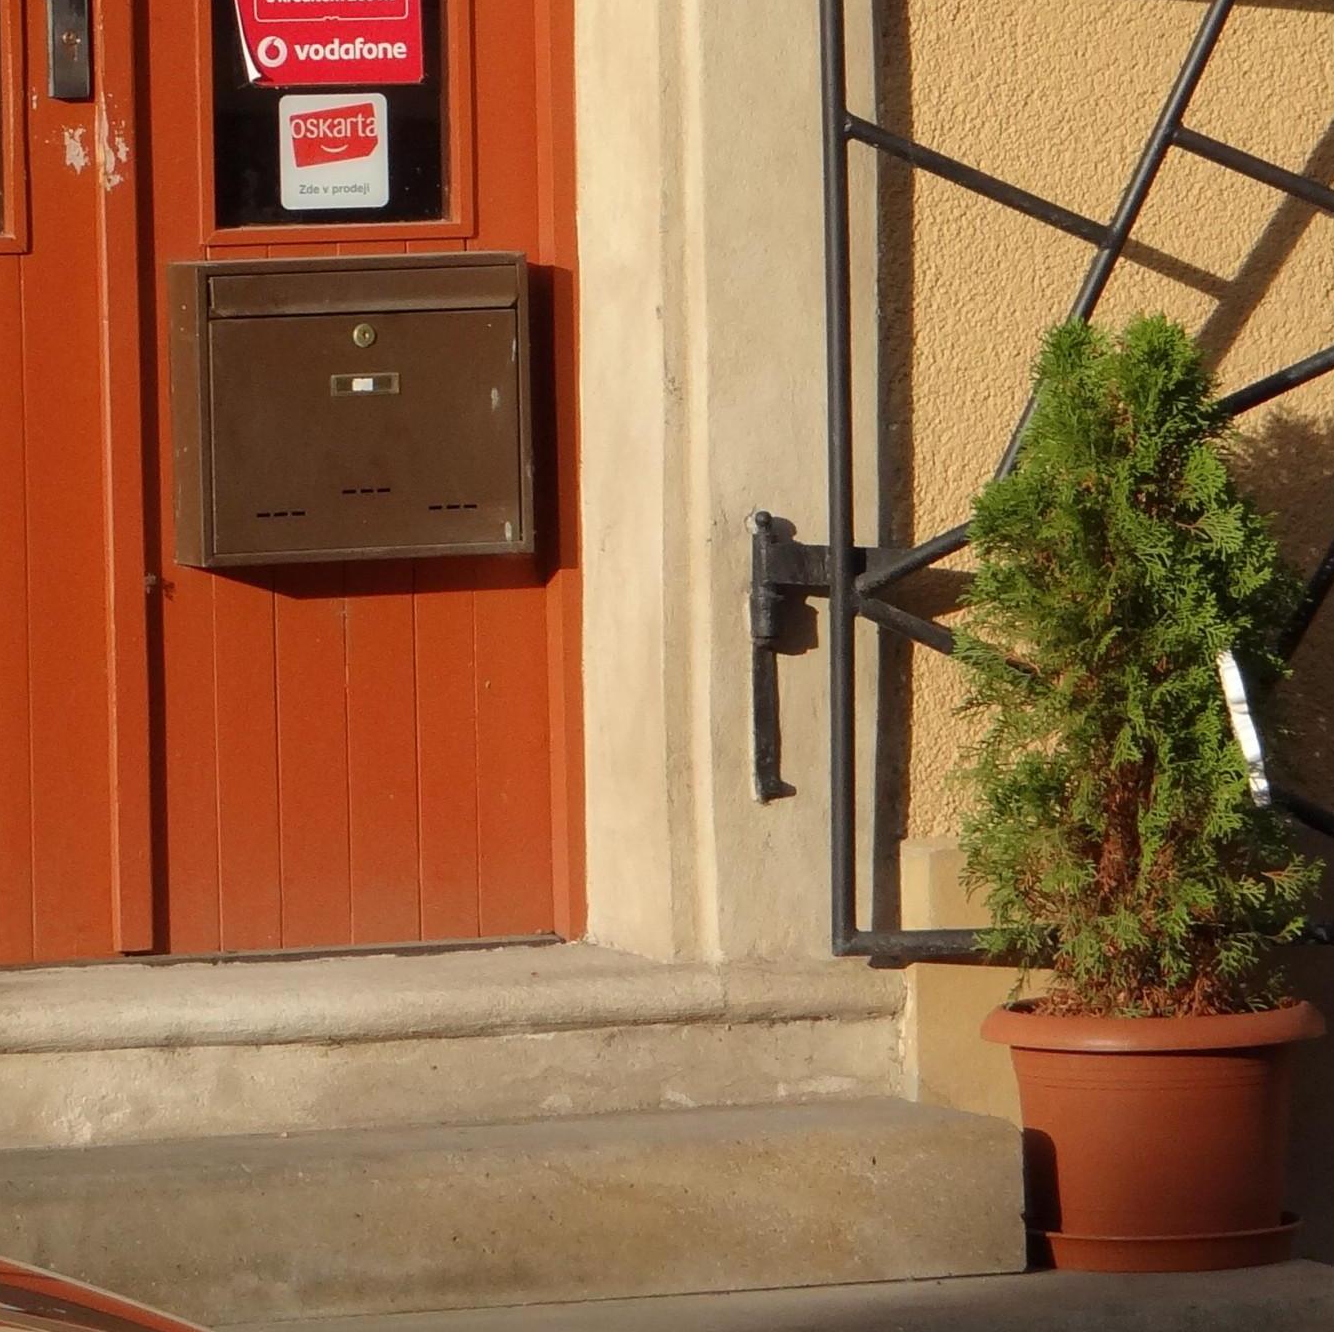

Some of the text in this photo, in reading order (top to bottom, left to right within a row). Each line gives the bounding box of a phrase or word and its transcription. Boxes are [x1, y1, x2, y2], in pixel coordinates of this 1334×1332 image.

[294, 37, 407, 61] vodafone
[291, 113, 378, 139] oskarta
[299, 183, 370, 196] Zde v prodeji
